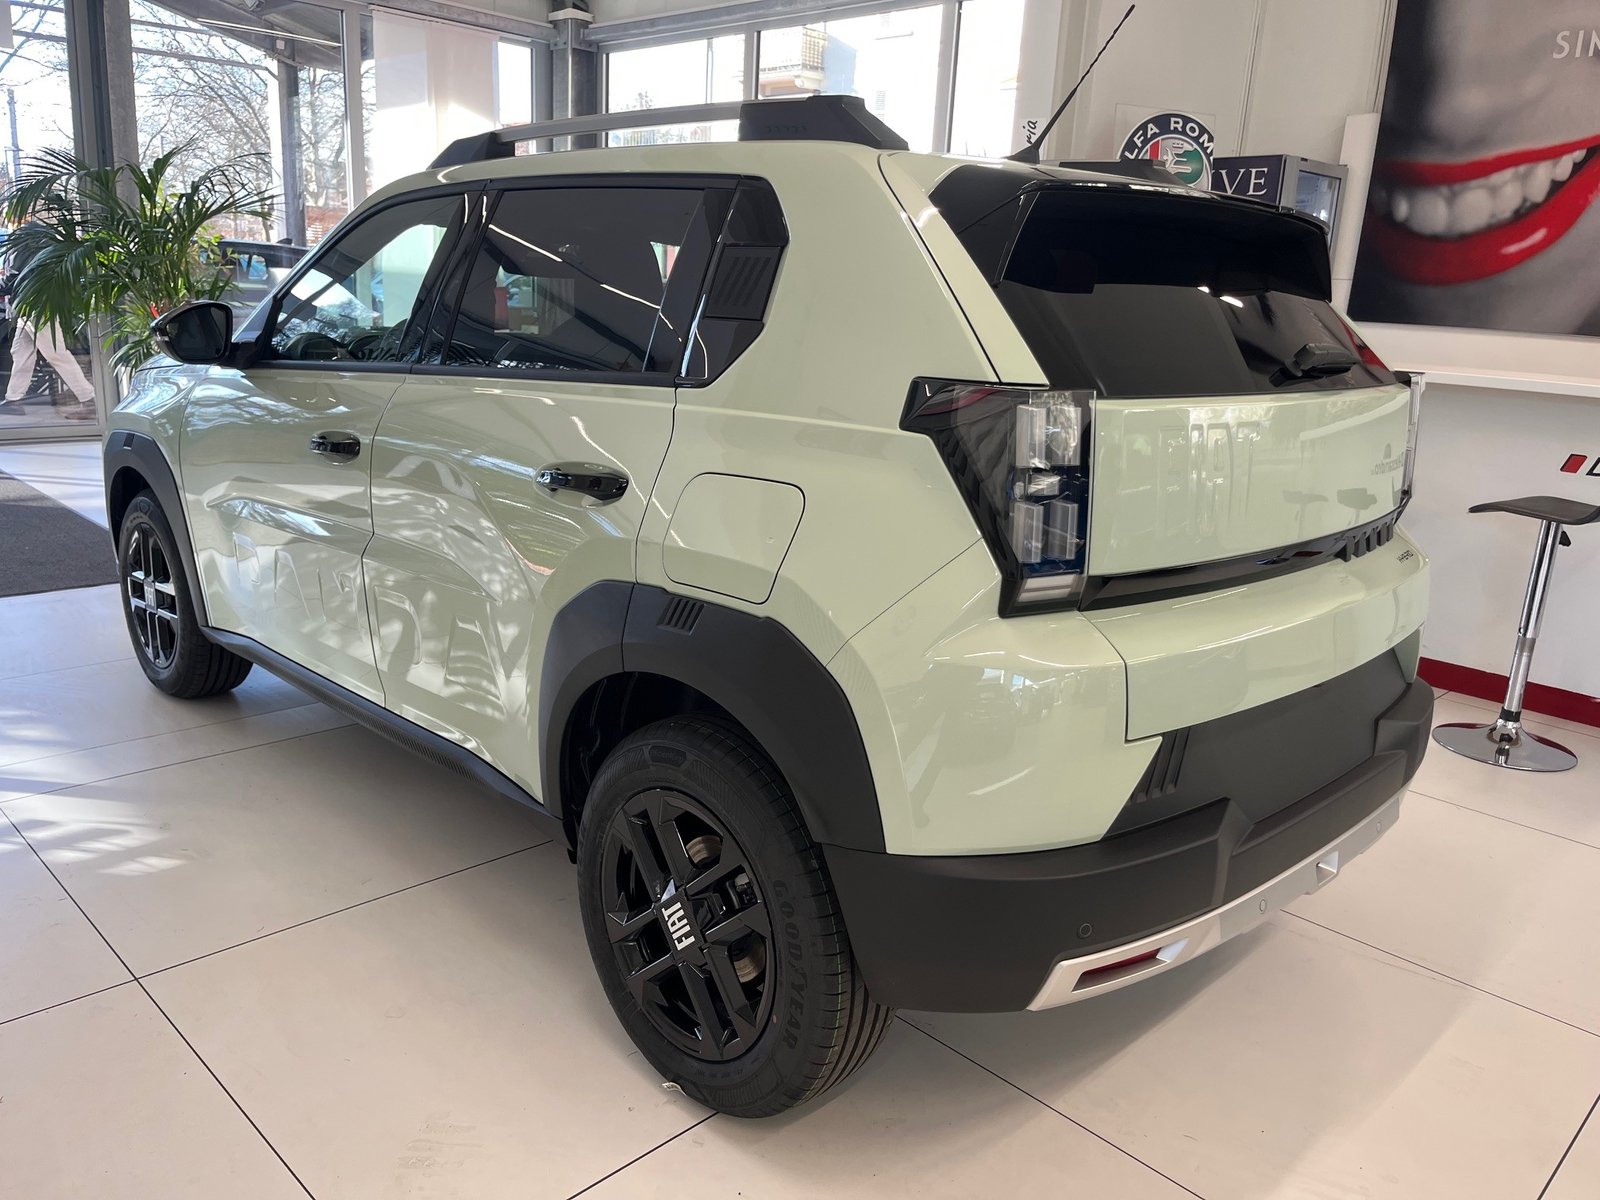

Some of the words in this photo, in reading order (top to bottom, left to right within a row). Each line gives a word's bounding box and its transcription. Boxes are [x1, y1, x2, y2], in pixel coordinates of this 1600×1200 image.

[1022, 120, 1038, 145] ria
[1124, 123, 1160, 160] LFA
[1169, 117, 1214, 160] ROM
[1212, 168, 1268, 196] VE
[661, 901, 696, 951] FIAT
[773, 879, 808, 1050] GOODYEAR
